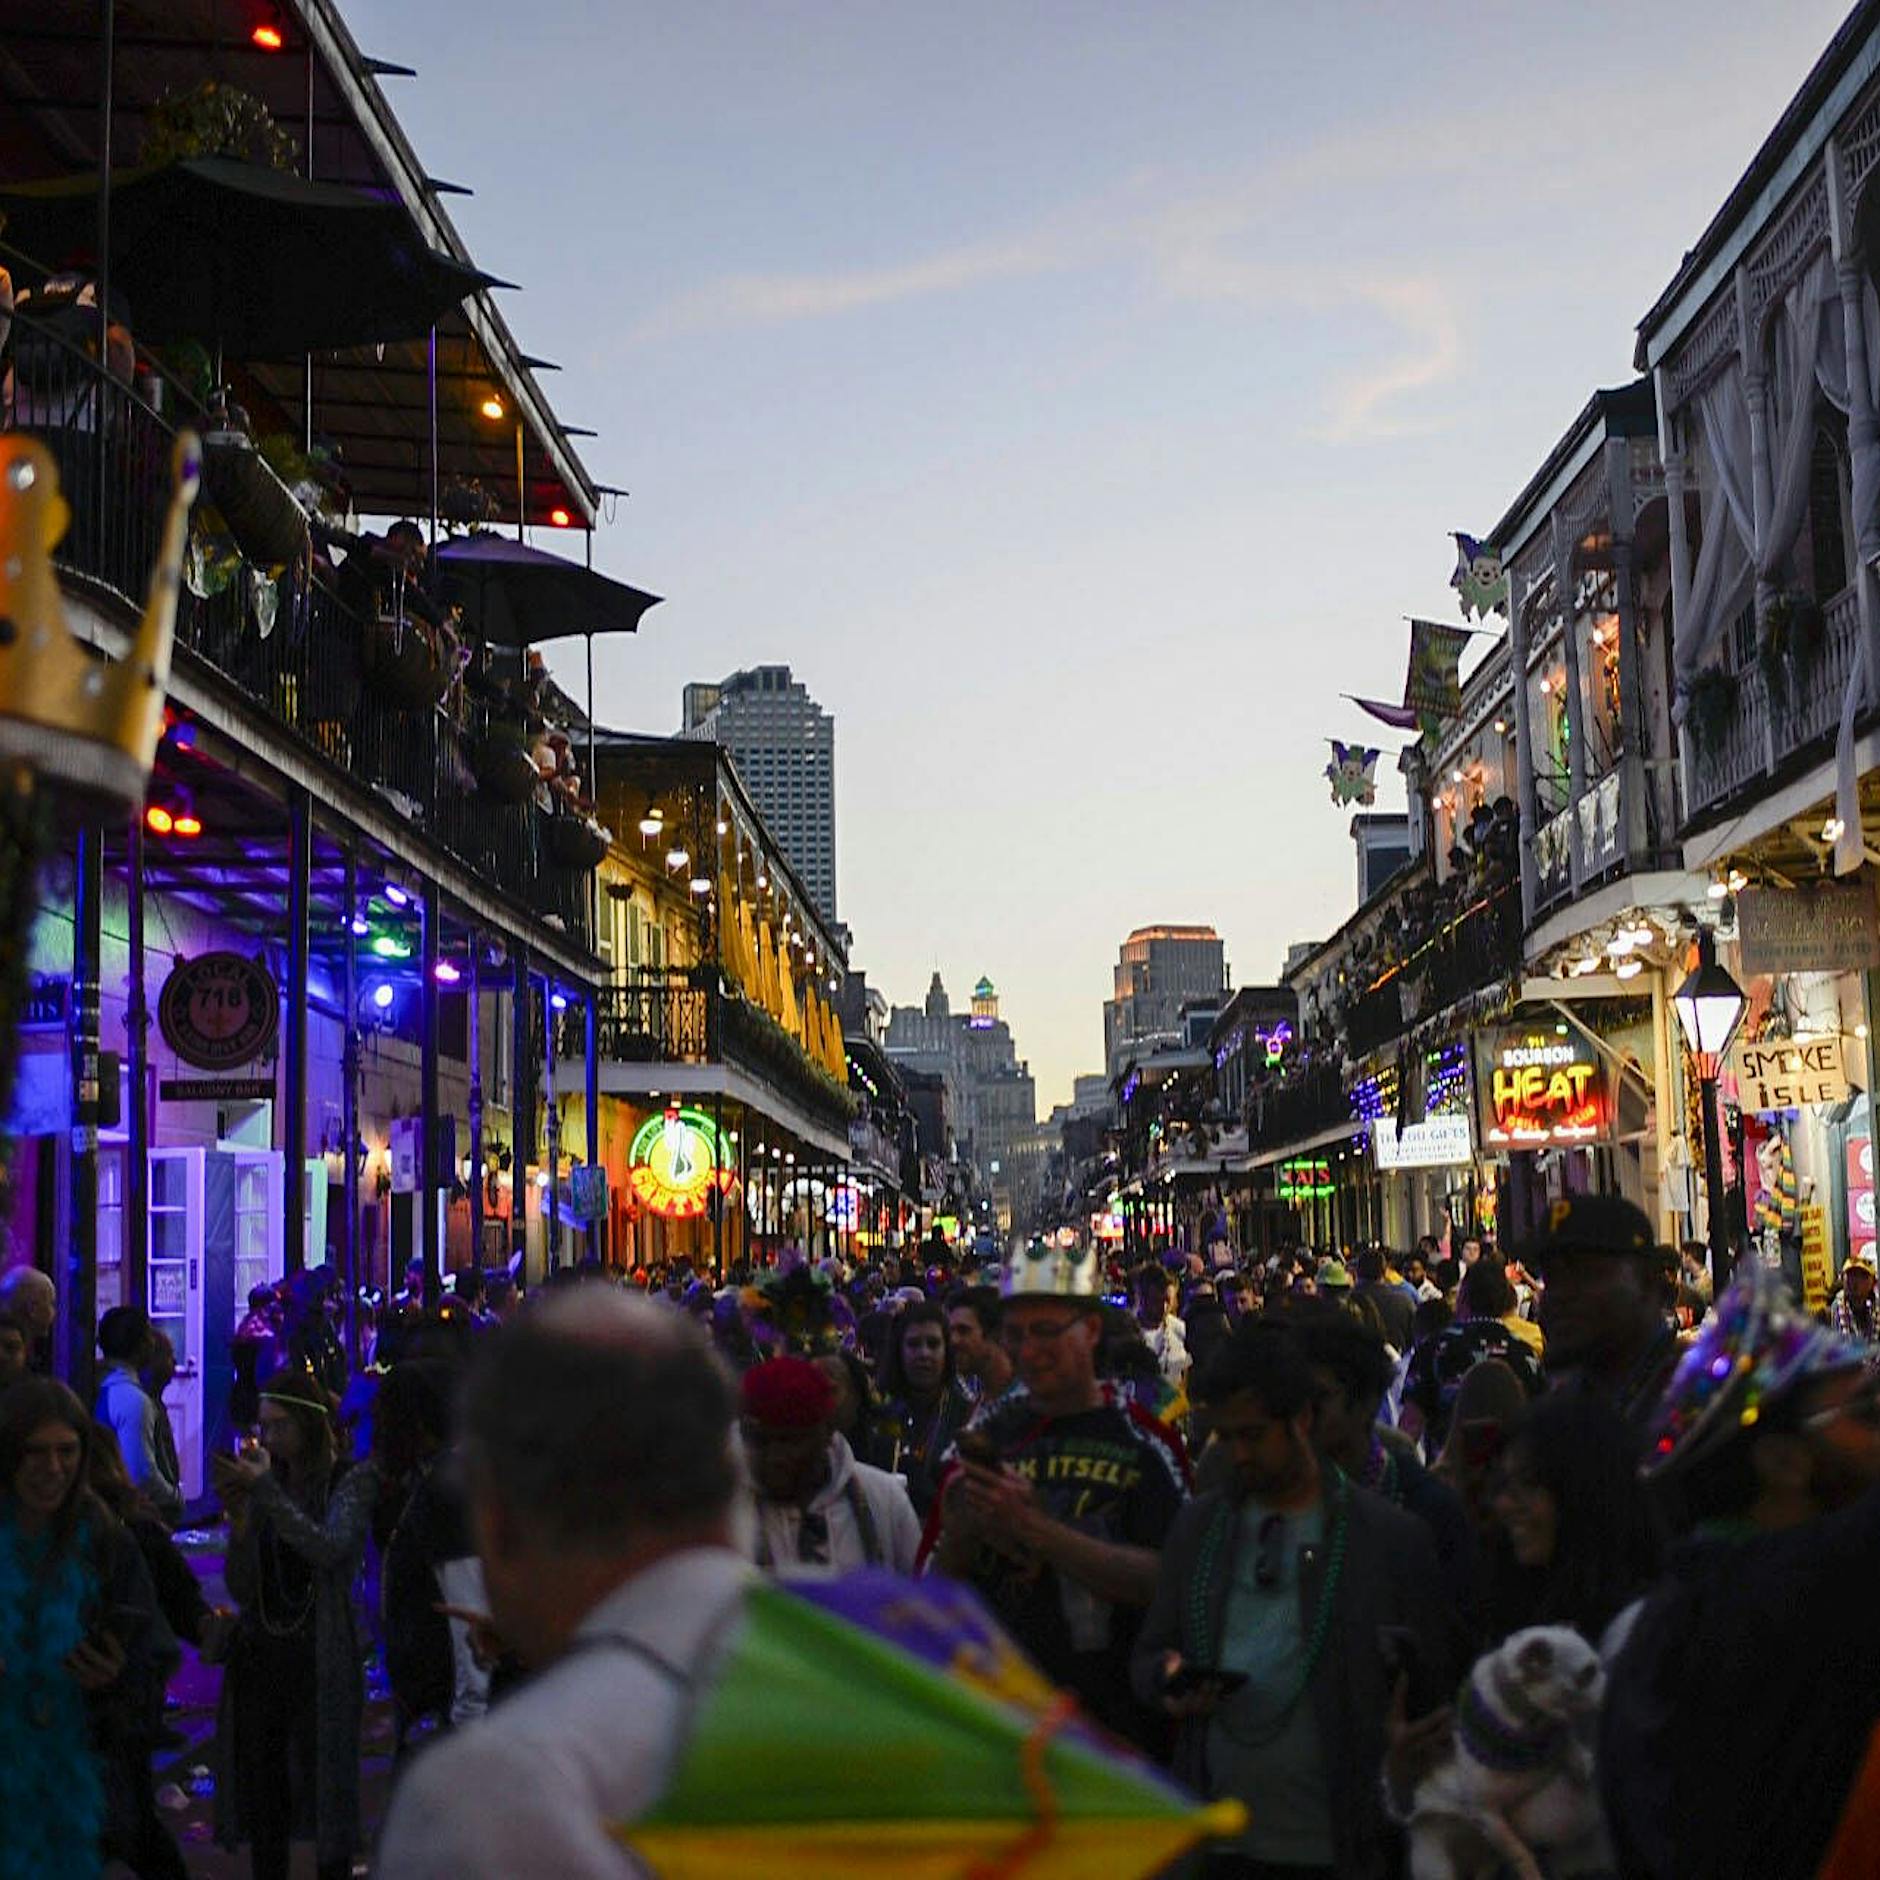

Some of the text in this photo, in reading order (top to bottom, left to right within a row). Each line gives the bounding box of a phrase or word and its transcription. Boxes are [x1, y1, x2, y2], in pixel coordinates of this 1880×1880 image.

[1503, 1046, 1575, 1067] BOURBON
[1743, 1045, 1837, 1079] SMOKE
[1493, 1065, 1594, 1123] HEAT
[1047, 1455, 1143, 1488] ITSELF
